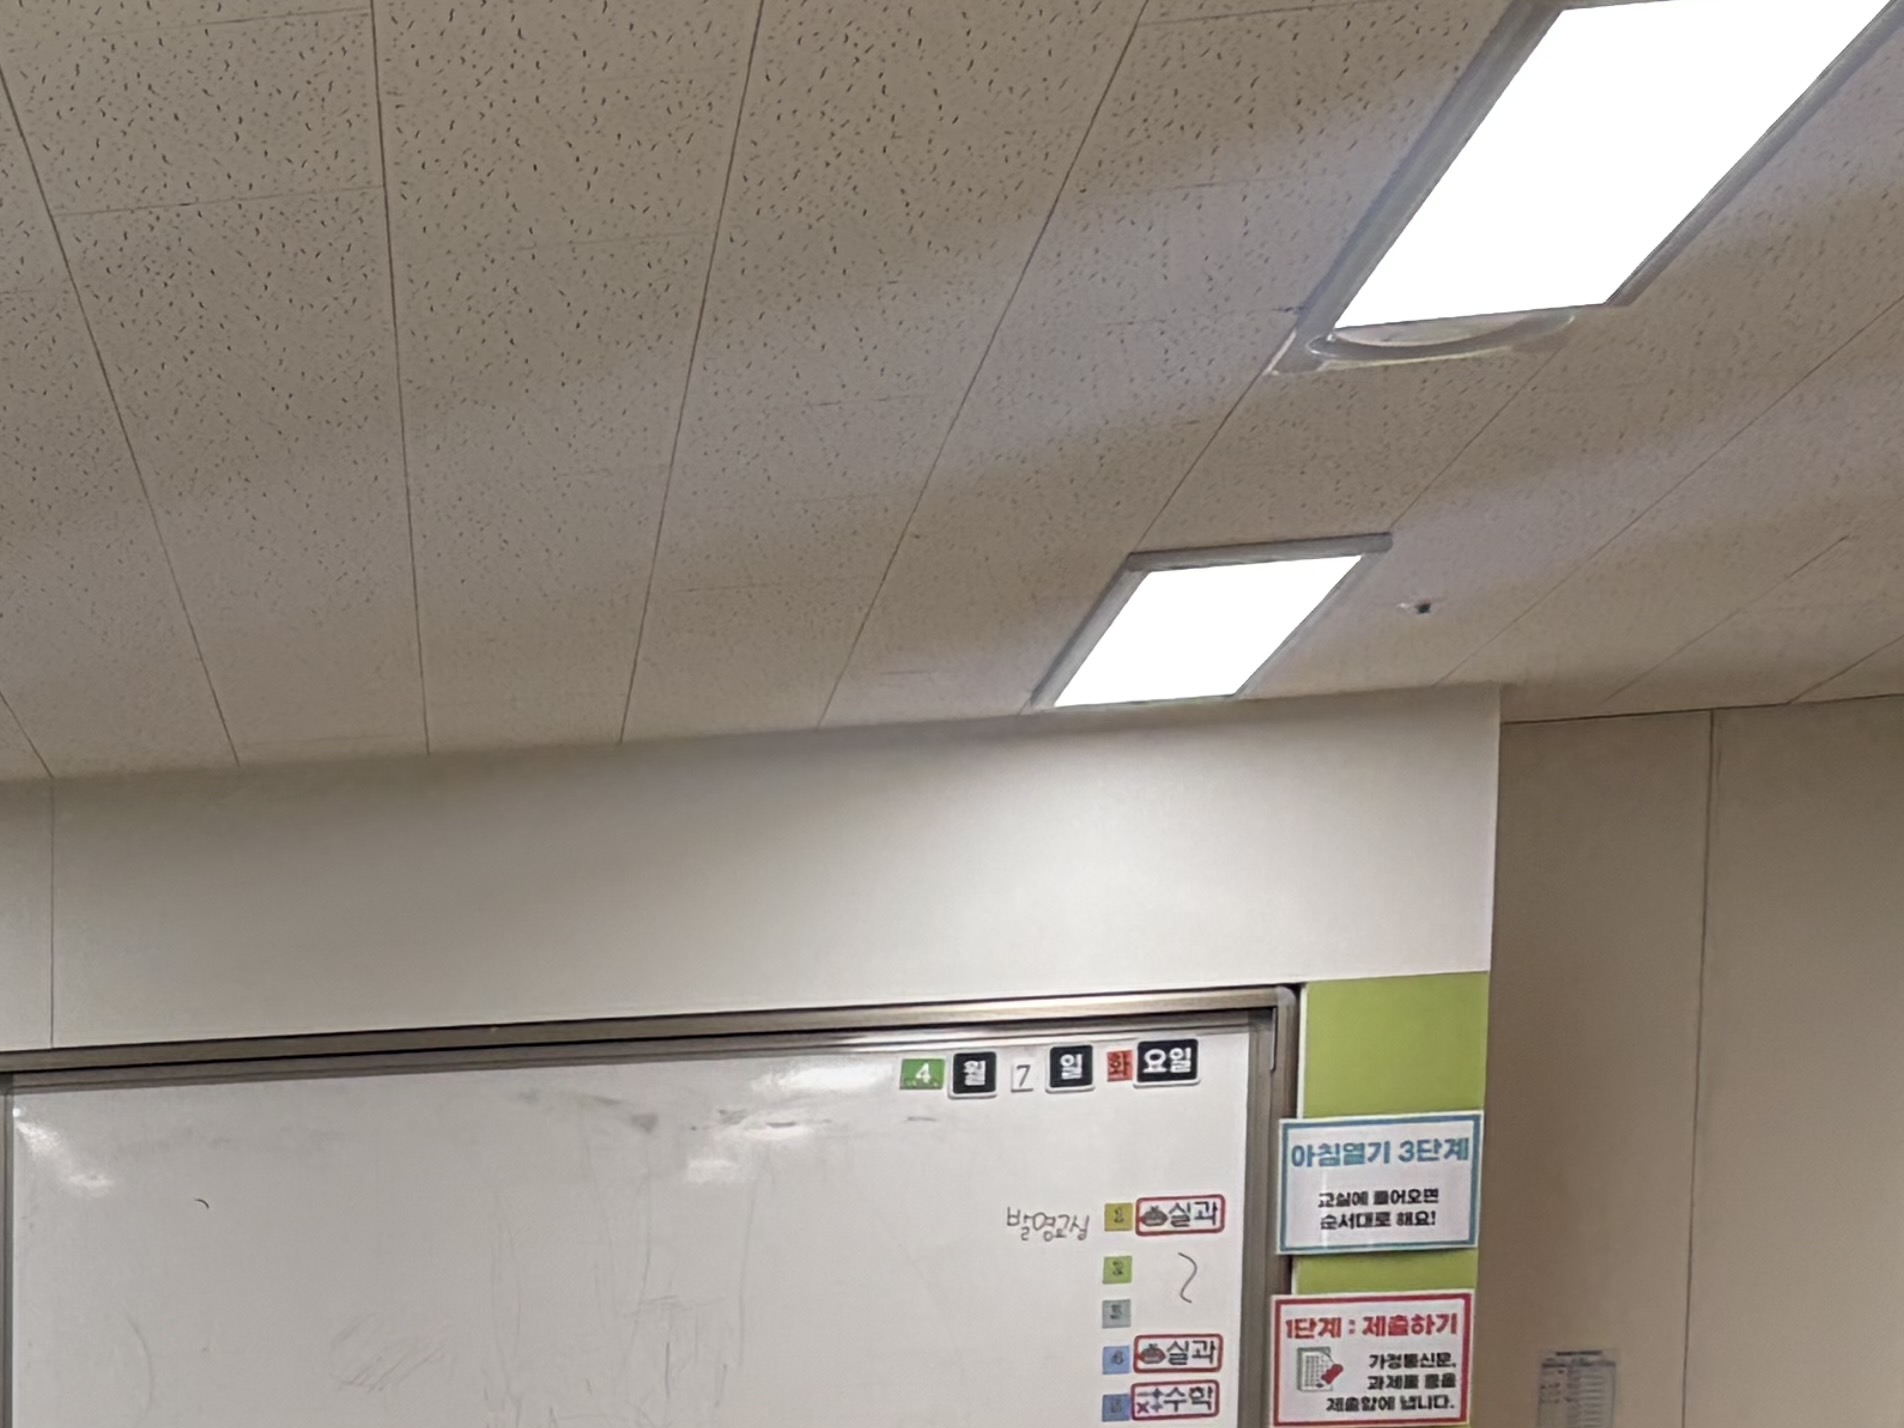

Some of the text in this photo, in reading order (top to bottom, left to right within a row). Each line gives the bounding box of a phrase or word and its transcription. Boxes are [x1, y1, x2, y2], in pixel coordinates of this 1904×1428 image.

[1017, 1065, 1031, 1087] 7
[1060, 1053, 1083, 1080] 일
[1143, 1047, 1192, 1074] 요일
[1291, 1136, 1470, 1169] 아침열기 3단계
[1317, 1187, 1440, 1209] 교실에 들어오면
[1169, 1201, 1218, 1227] 실과
[1320, 1209, 1437, 1231] 순서대로 해요!
[1285, 1316, 1342, 1341] 1단계
[1362, 1313, 1458, 1337] 제출하기
[1167, 1340, 1216, 1365] 실과
[1164, 1385, 1213, 1412] 수학
